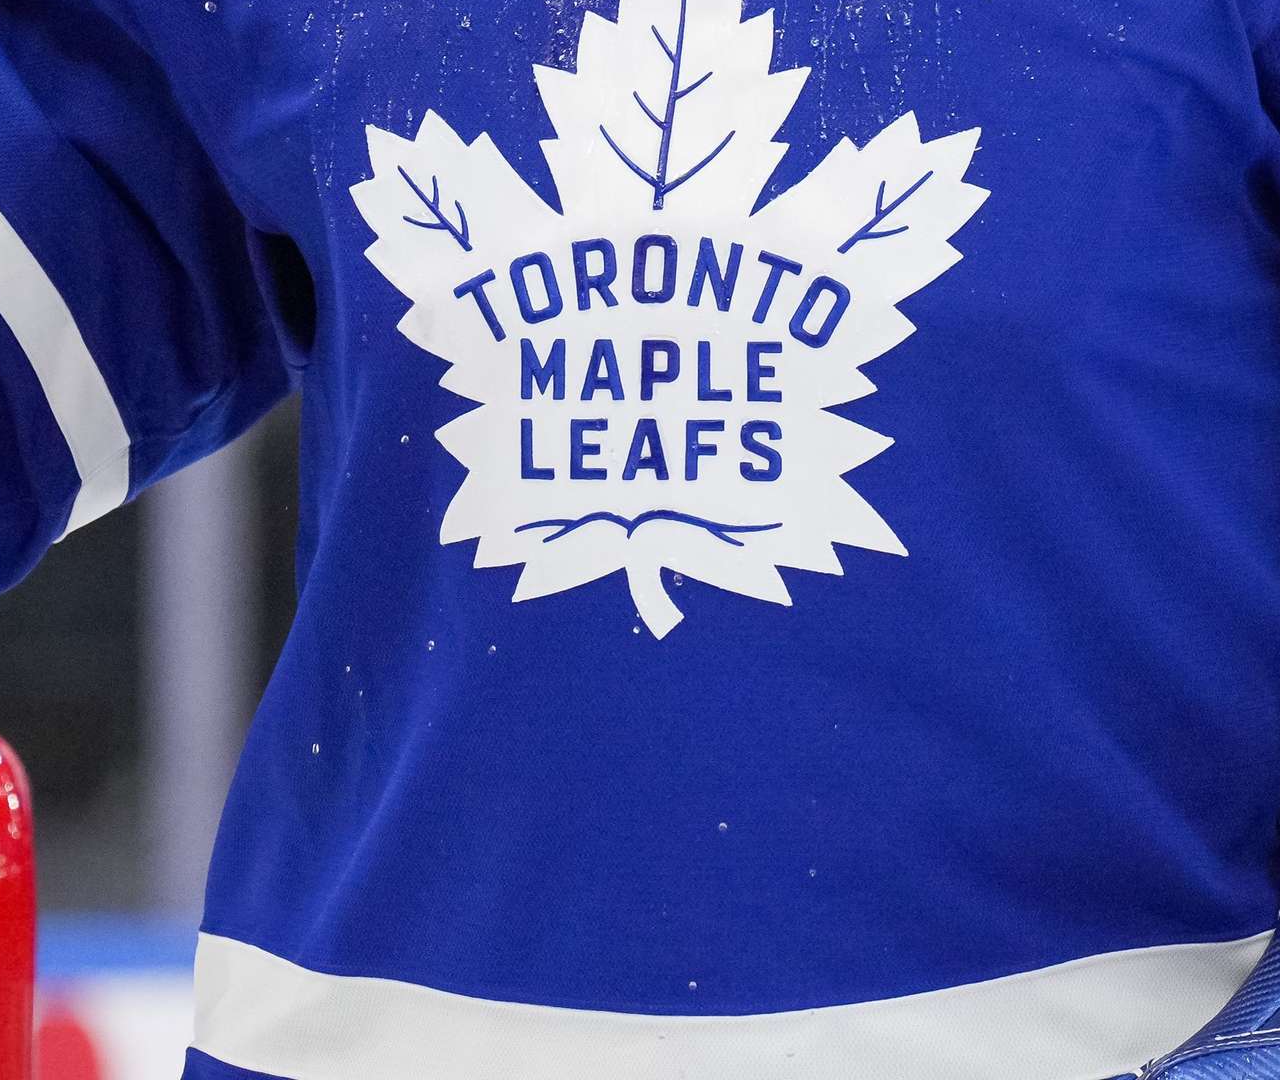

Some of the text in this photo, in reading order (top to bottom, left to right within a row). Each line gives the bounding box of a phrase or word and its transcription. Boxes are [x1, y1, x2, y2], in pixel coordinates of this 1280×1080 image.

[453, 233, 851, 349] TORONTO
[520, 337, 783, 403] MAPLE
[520, 417, 783, 482] LEAFS
